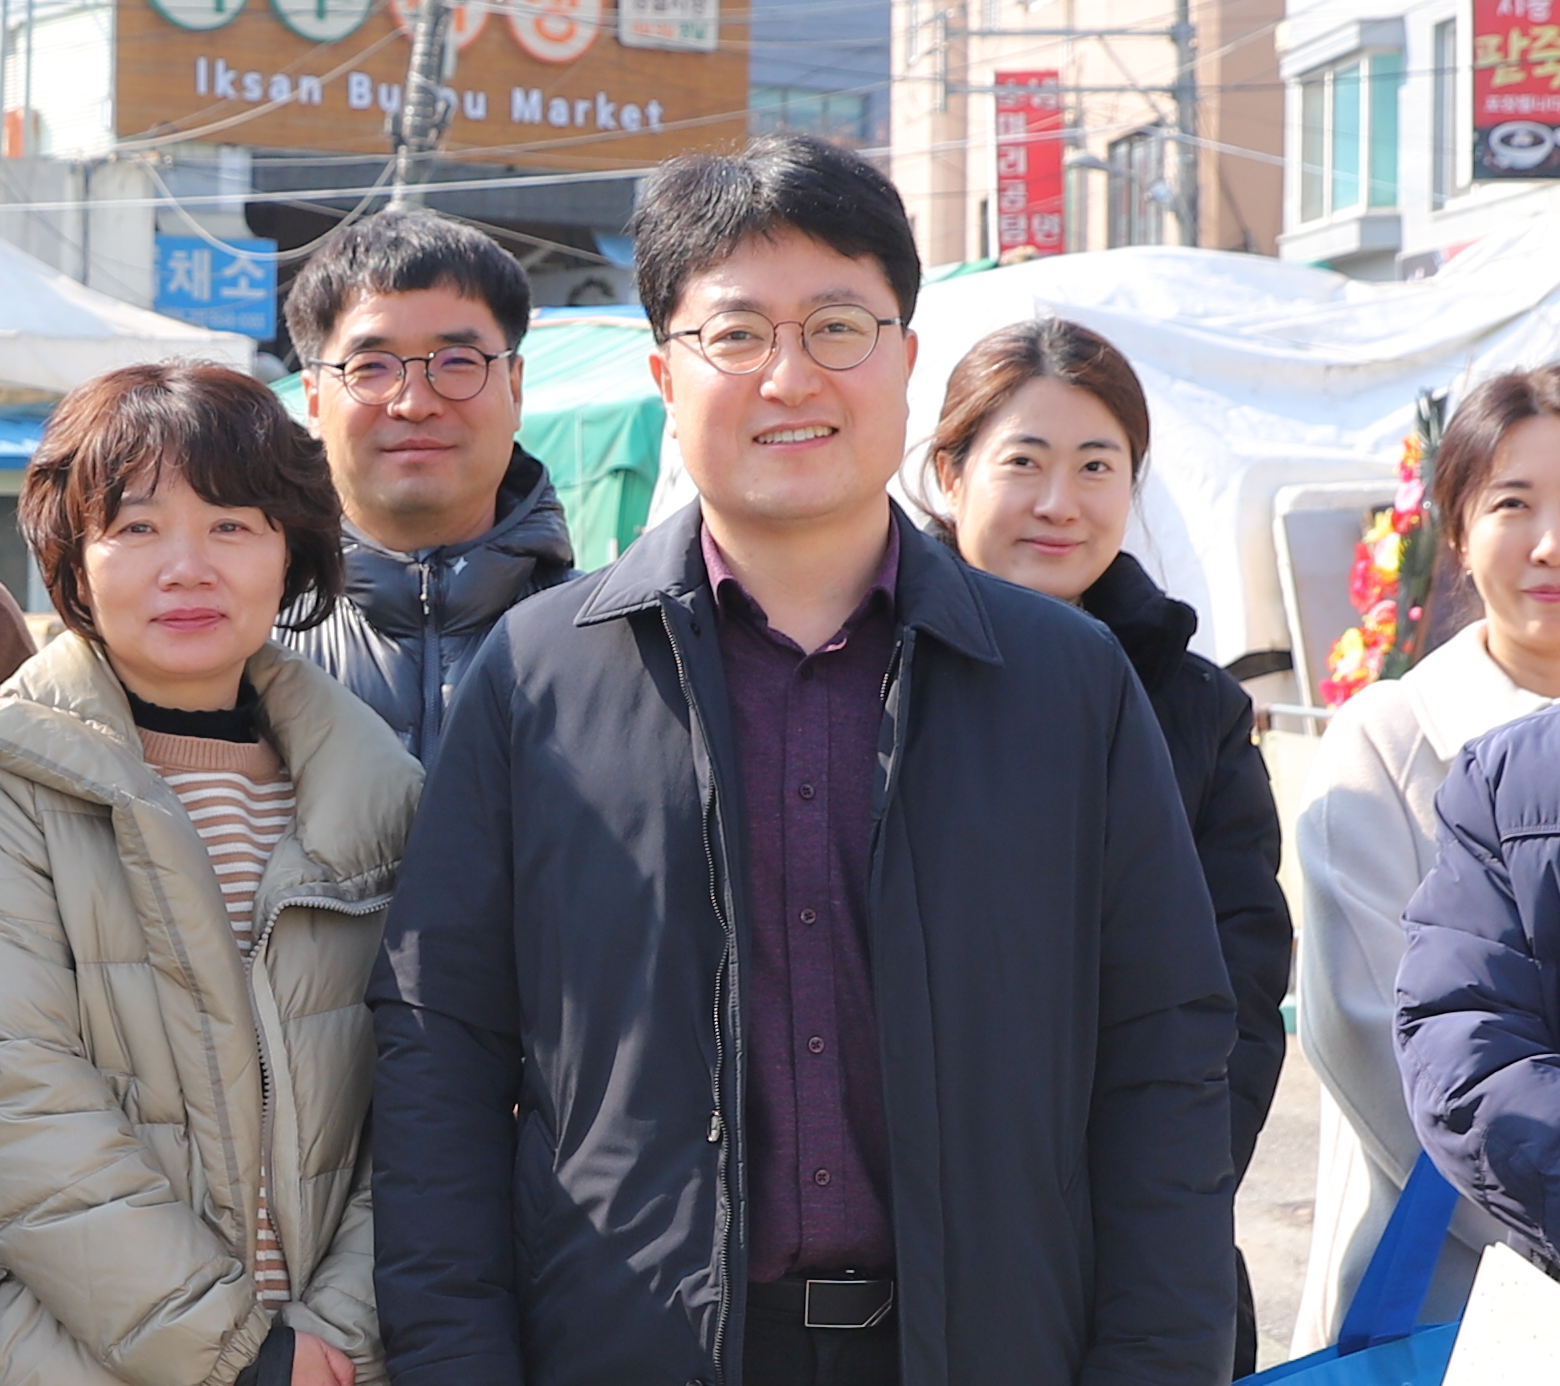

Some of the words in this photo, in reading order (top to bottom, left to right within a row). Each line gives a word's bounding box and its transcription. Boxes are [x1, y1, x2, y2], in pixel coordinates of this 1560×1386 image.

[195, 57, 323, 104] Iksan
[349, 70, 488, 122] Buu
[510, 85, 665, 135] Market
[154, 246, 268, 303] 채소
